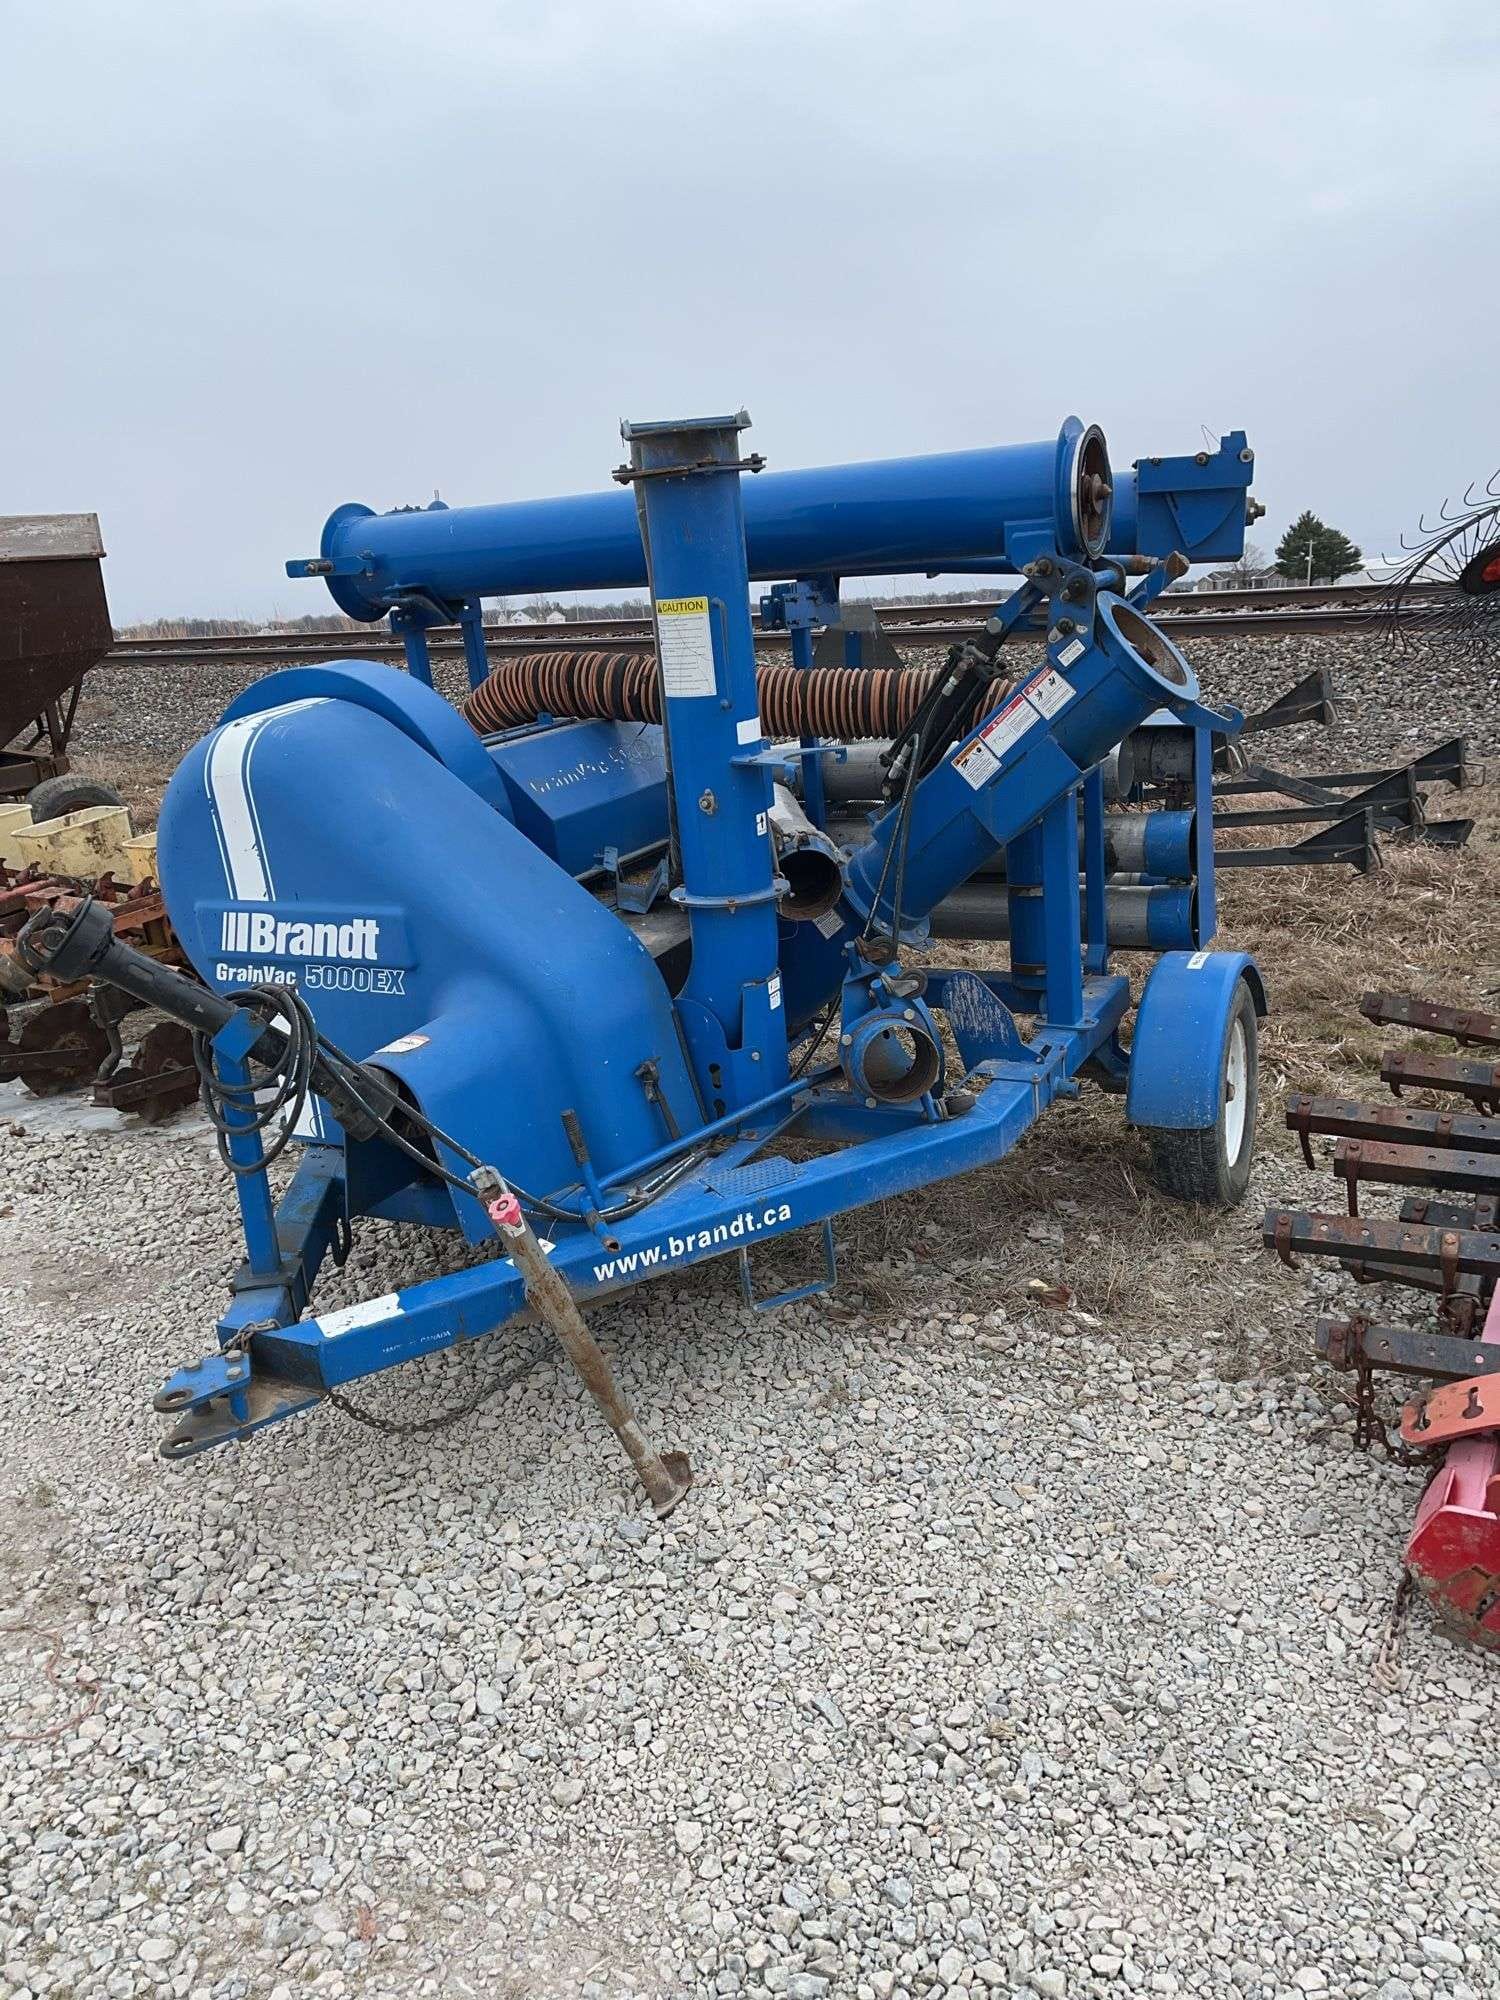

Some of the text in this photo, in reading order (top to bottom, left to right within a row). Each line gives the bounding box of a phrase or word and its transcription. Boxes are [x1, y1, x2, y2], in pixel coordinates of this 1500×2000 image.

[662, 601, 704, 613] CAUTION
[250, 912, 380, 961] Brandt
[216, 963, 406, 995] GrainVac 5000EX
[592, 1204, 792, 1282] www.brandt.ca
